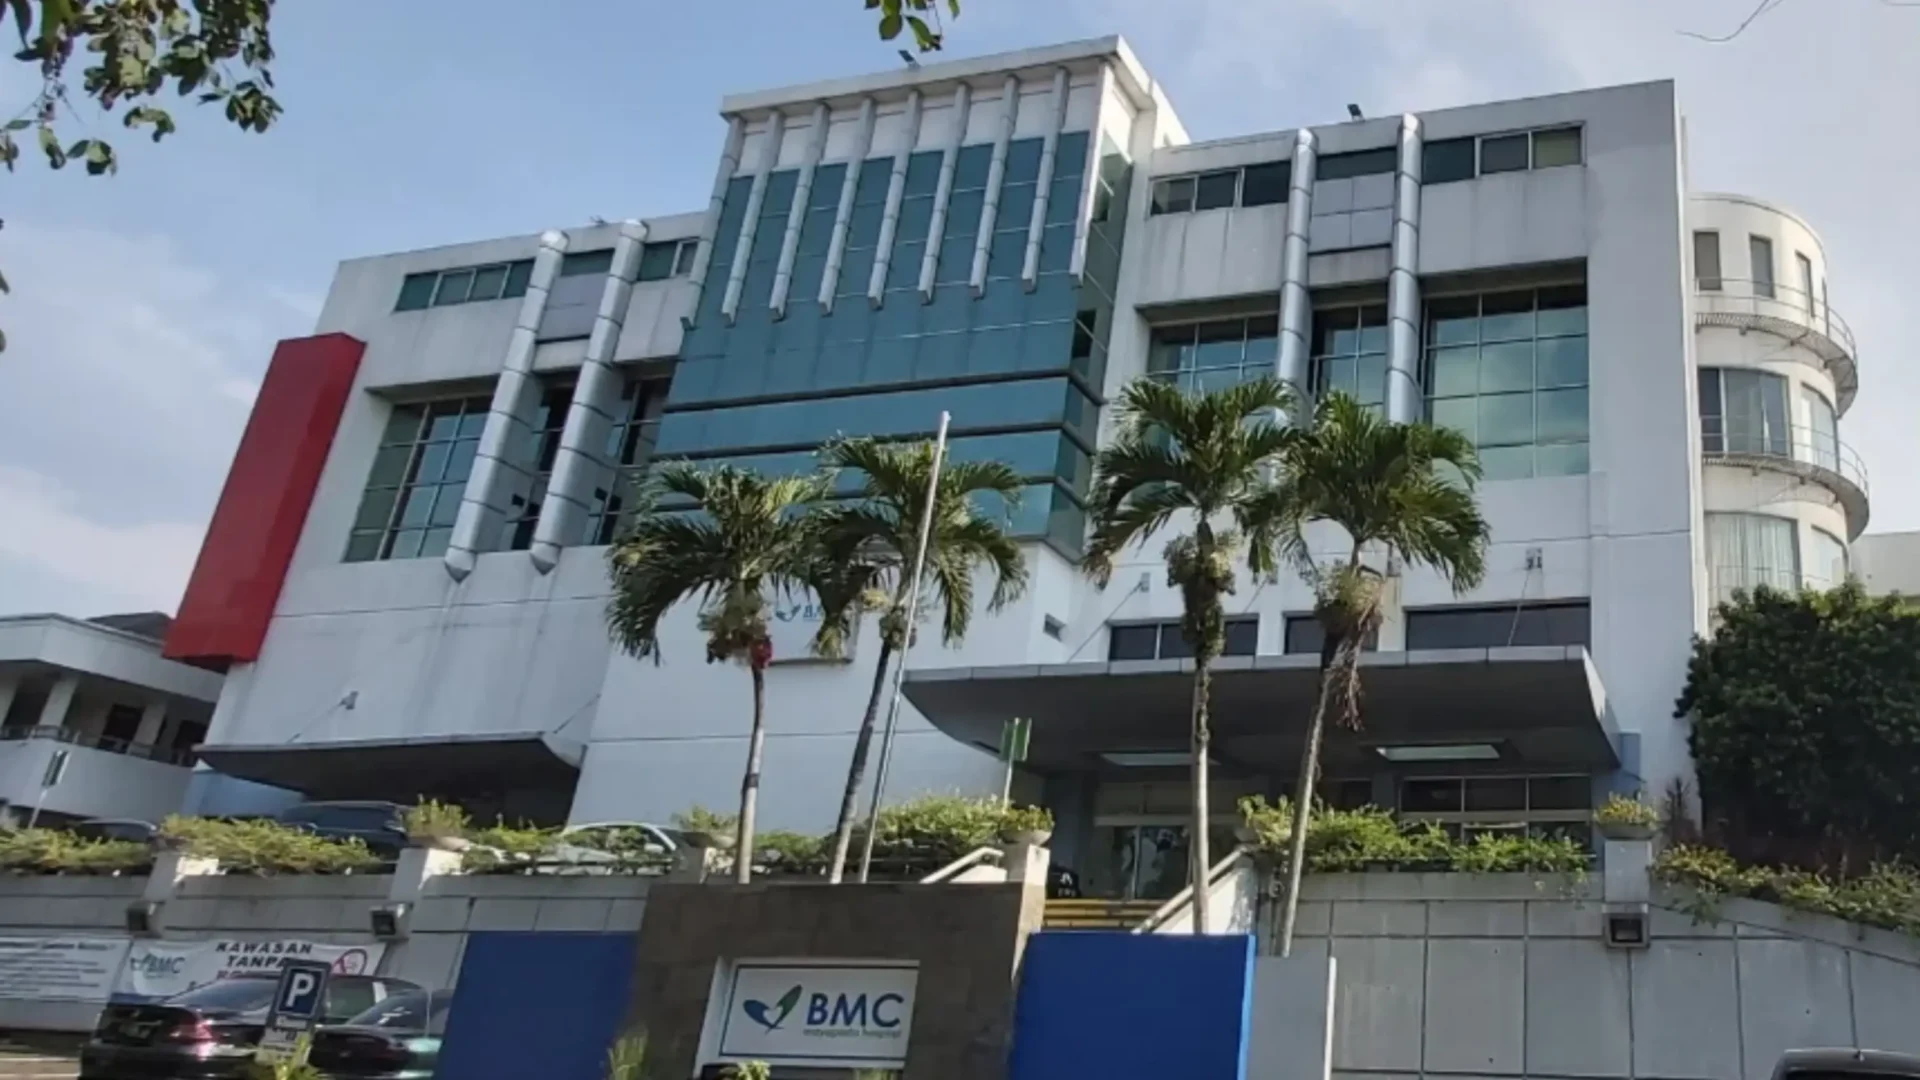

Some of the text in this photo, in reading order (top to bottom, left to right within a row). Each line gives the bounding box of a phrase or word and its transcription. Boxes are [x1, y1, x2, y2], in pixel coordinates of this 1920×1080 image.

[216, 942, 313, 954] KAWASAN
[285, 973, 315, 1008] P
[807, 992, 905, 1028] BMC
